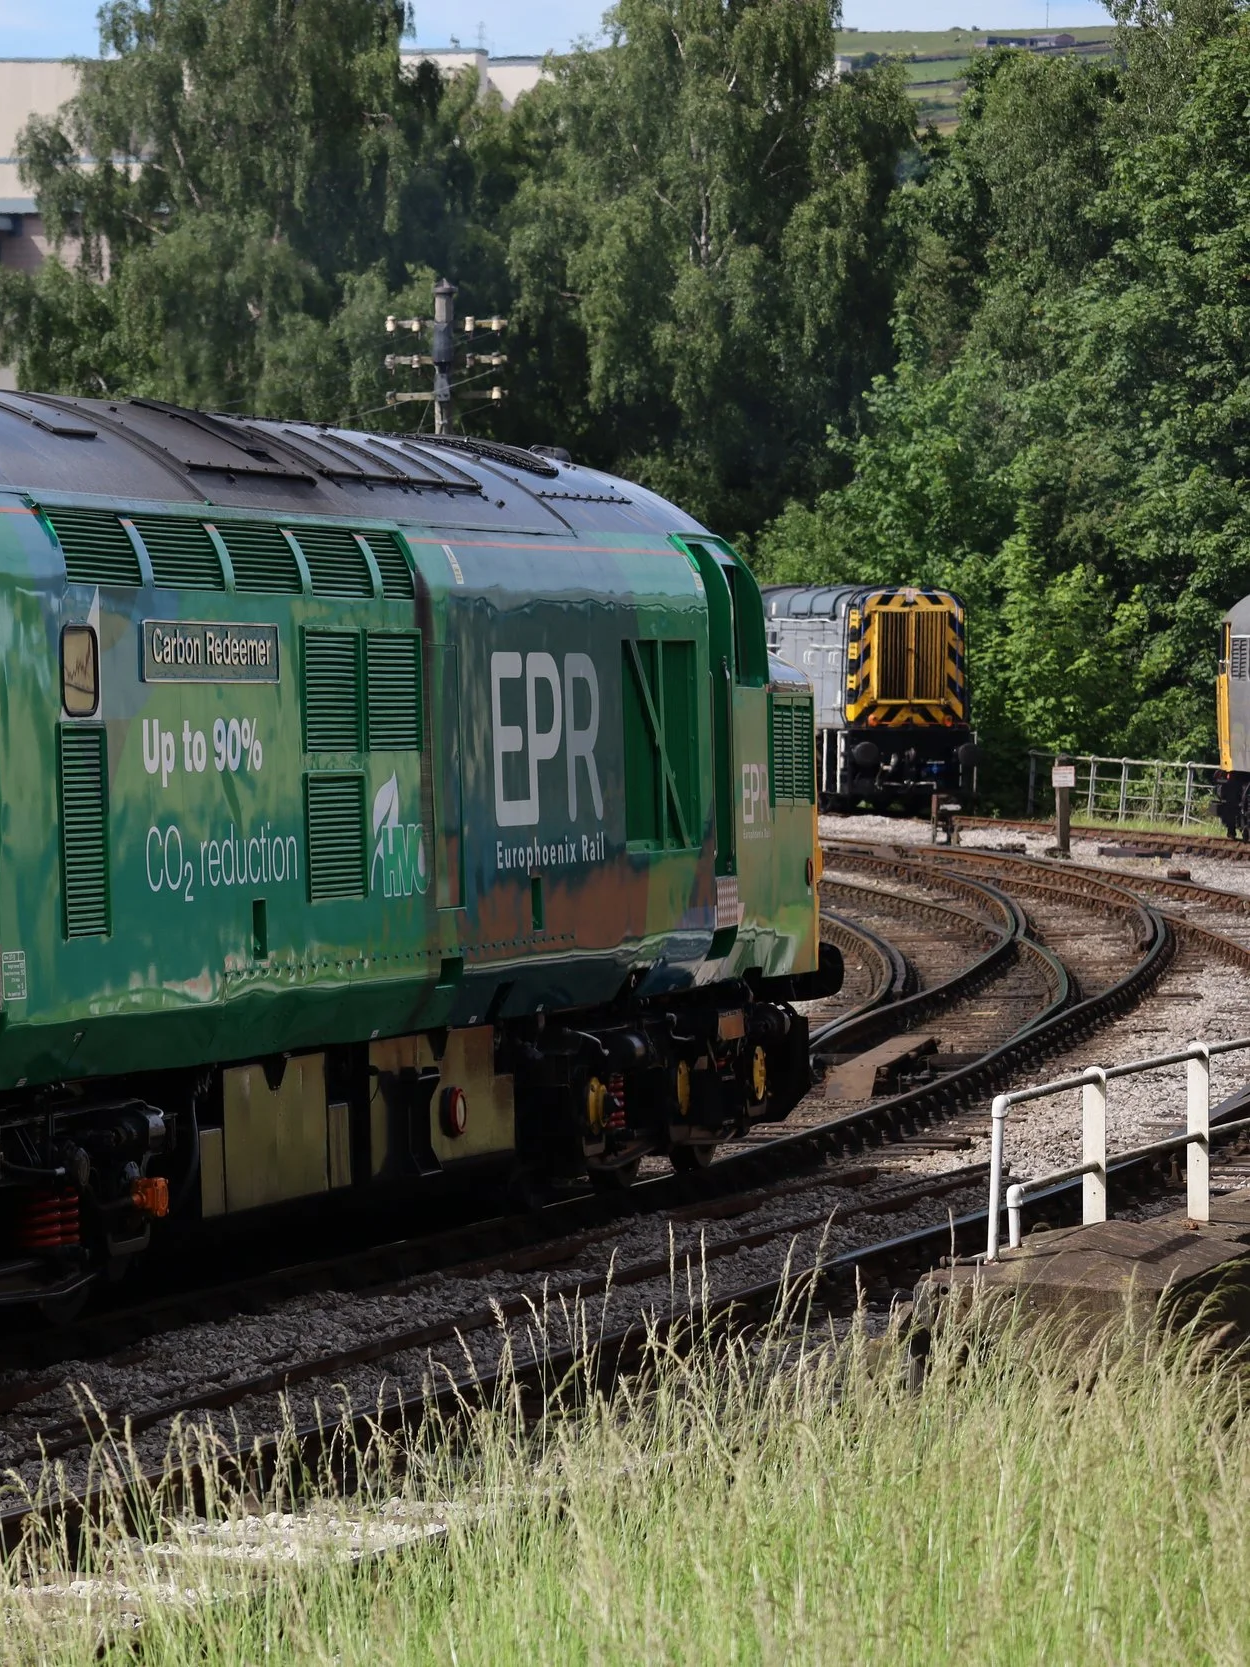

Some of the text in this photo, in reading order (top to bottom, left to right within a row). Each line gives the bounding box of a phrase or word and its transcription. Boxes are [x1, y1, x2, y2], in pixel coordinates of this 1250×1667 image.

[152, 627, 271, 666] Carbon Redeemer
[142, 717, 263, 788] Up to 90%
[491, 651, 603, 827] EPR
[742, 763, 771, 824] EPR
[200, 821, 298, 887] reduction
[496, 831, 605, 876] Europhoenix Rail
